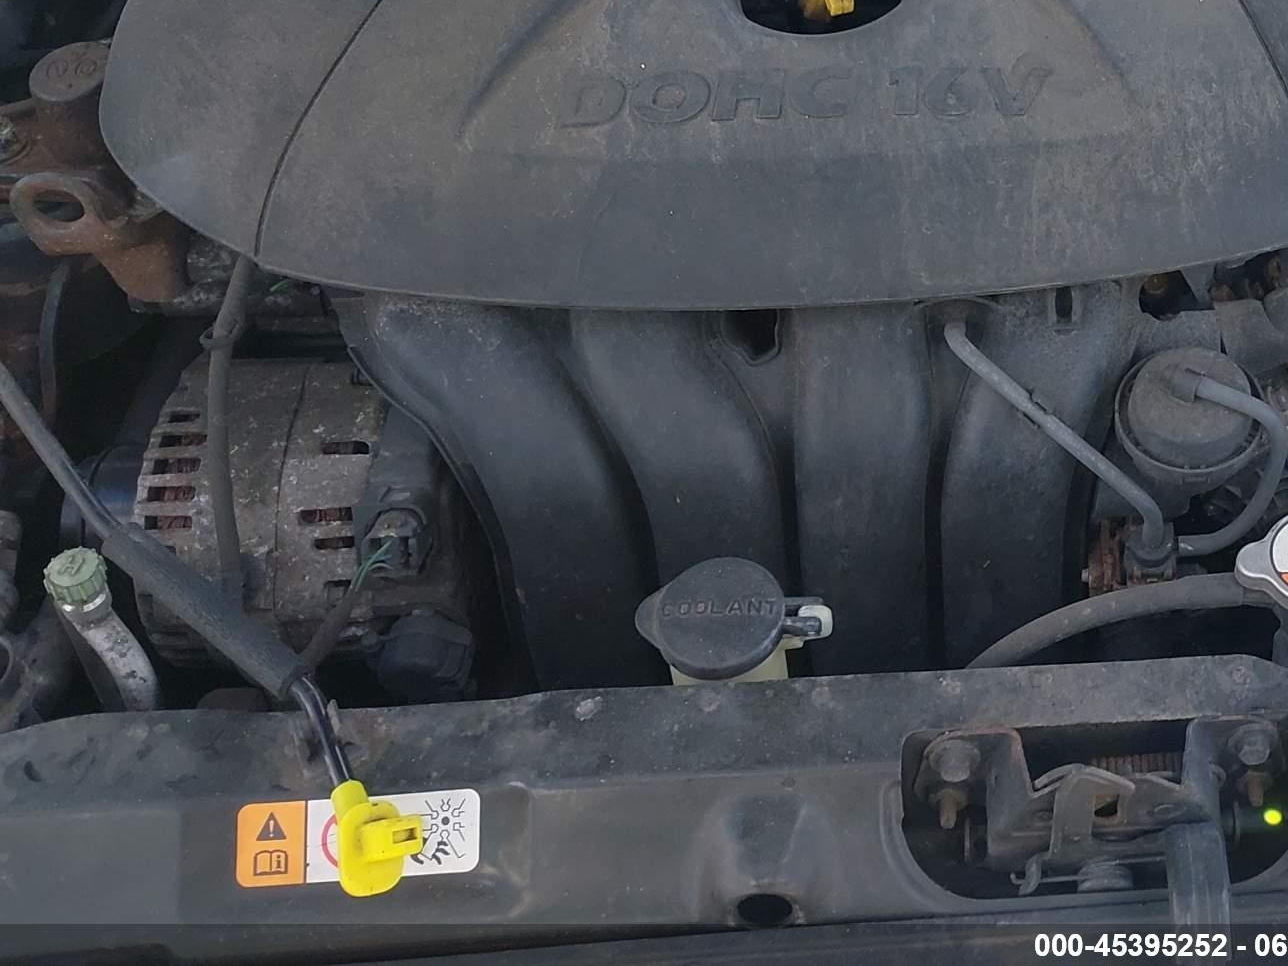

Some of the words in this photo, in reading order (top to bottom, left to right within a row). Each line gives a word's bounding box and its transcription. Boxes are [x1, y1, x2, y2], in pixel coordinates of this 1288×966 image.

[559, 66, 853, 128] DOHC
[888, 64, 1054, 122] 16V
[661, 597, 778, 619] COOLANT
